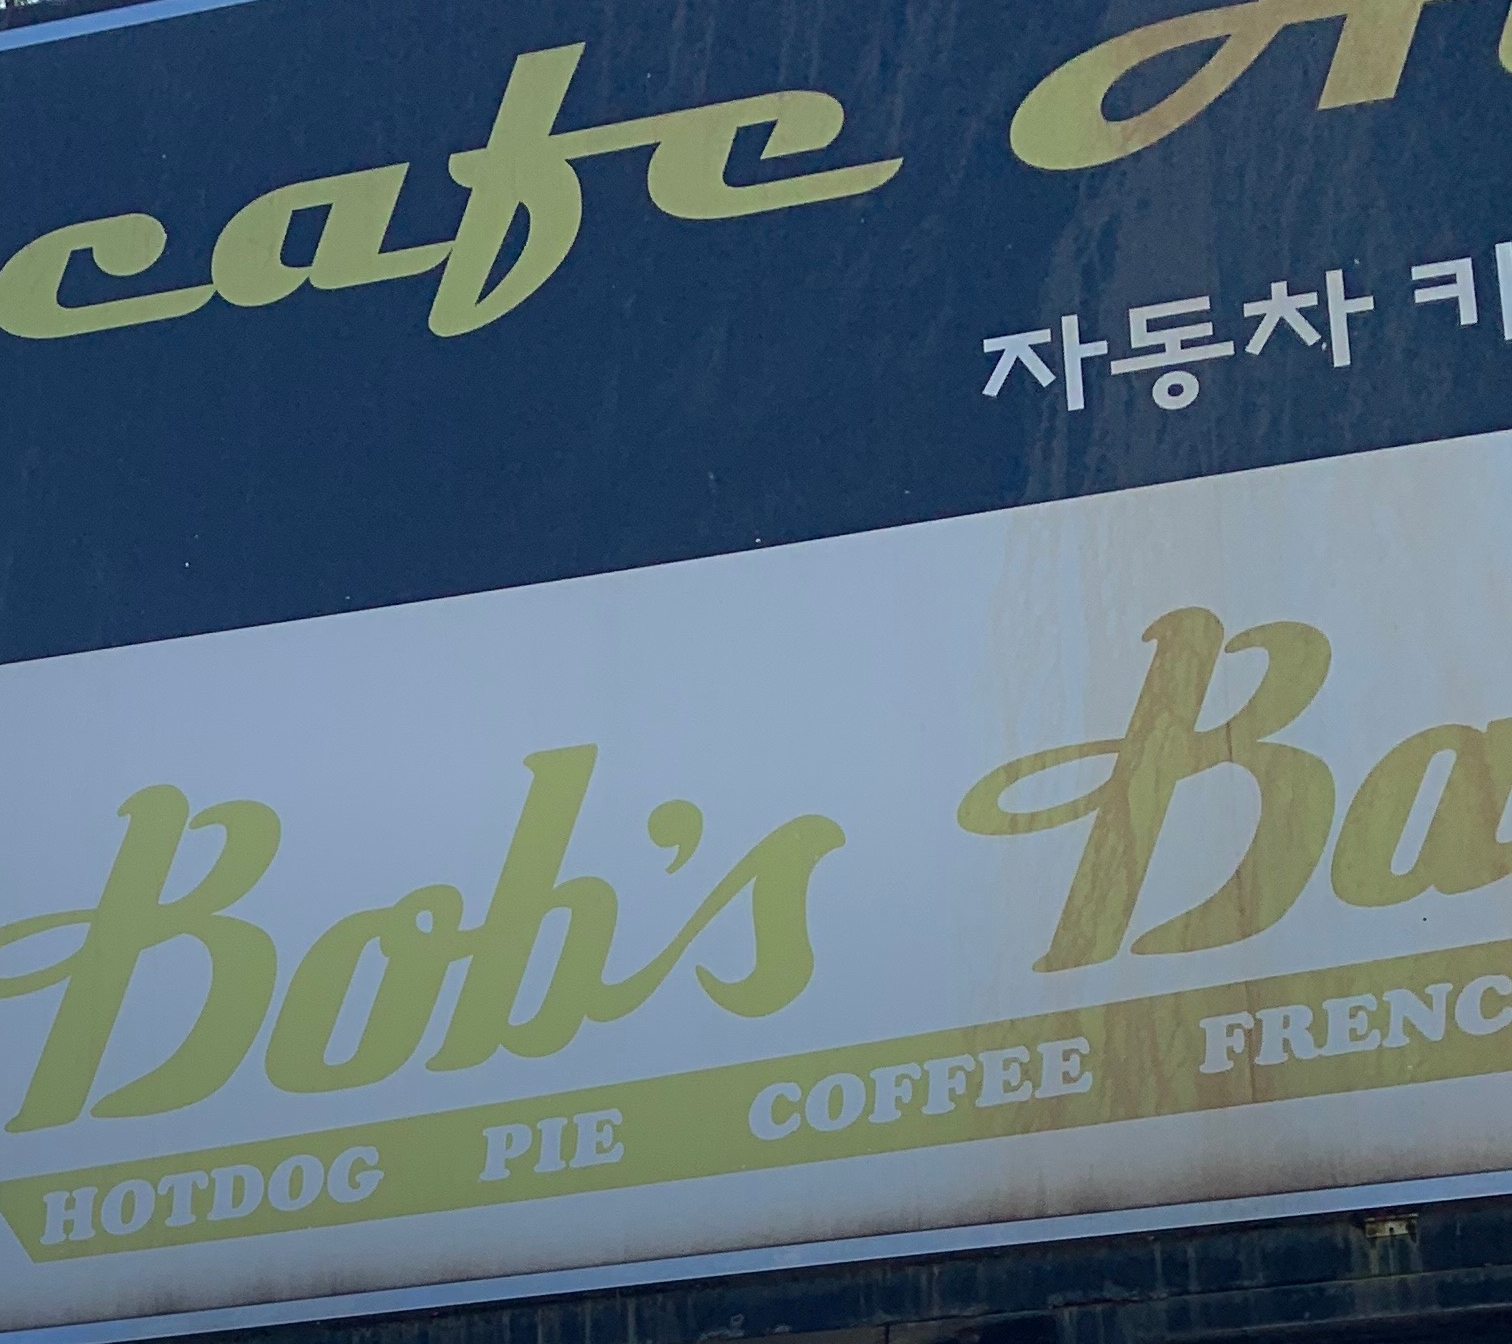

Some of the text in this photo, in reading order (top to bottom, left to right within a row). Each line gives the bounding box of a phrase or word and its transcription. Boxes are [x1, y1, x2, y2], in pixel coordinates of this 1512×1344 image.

[982, 269, 1375, 412] 자동차
[40, 975, 1512, 1245] HOTDOG PIE COFFEE FRENC
